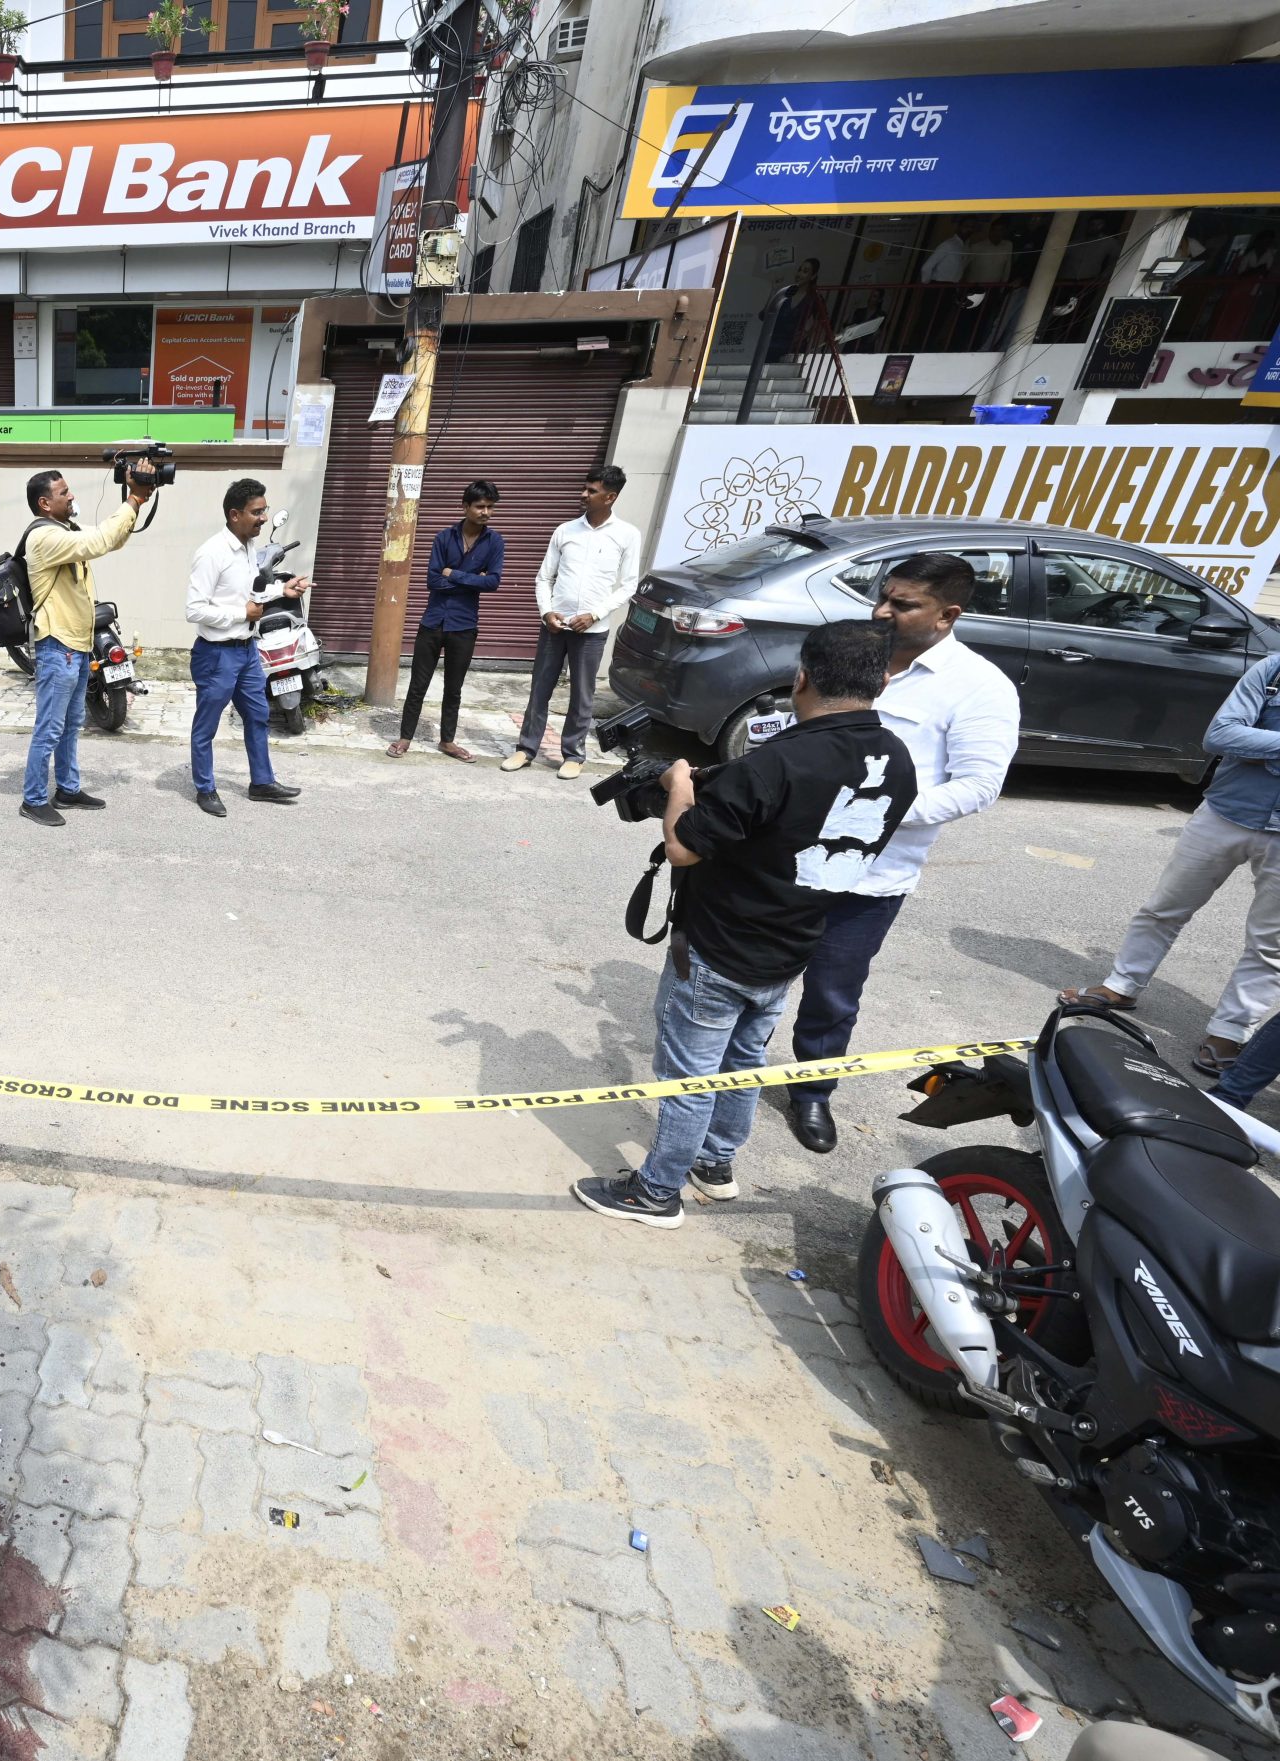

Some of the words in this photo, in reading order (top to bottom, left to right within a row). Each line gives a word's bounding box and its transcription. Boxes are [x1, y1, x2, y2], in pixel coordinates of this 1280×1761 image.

[767, 97, 876, 142] फेडरल
[885, 92, 948, 139] बैंक
[865, 159, 896, 173] नगर
[899, 156, 939, 172] शाखा
[103, 134, 363, 215] Bank
[208, 223, 248, 240] Vivek
[250, 221, 300, 239] Khand
[303, 219, 356, 236] Branch
[388, 223, 418, 240] TRAVE
[389, 243, 412, 259] CARD
[184, 313, 208, 322] ICICI
[210, 313, 235, 321] Bank
[1102, 361, 1135, 372] BADRI
[195, 375, 232, 383] property?
[203, 384, 225, 392] Capal
[830, 445, 1007, 517] BADRI
[1000, 445, 1280, 548] JEWELLERS
[80, 1088, 134, 1104] NOT
[143, 1095, 179, 1107] DO
[456, 1094, 583, 1110] POLICE
[594, 1087, 648, 1101] UP
[210, 1098, 310, 1113] SCENE
[321, 1100, 420, 1112] CRIME
[1134, 1259, 1204, 1358] RAIDER
[1124, 1495, 1155, 1530] TVS
